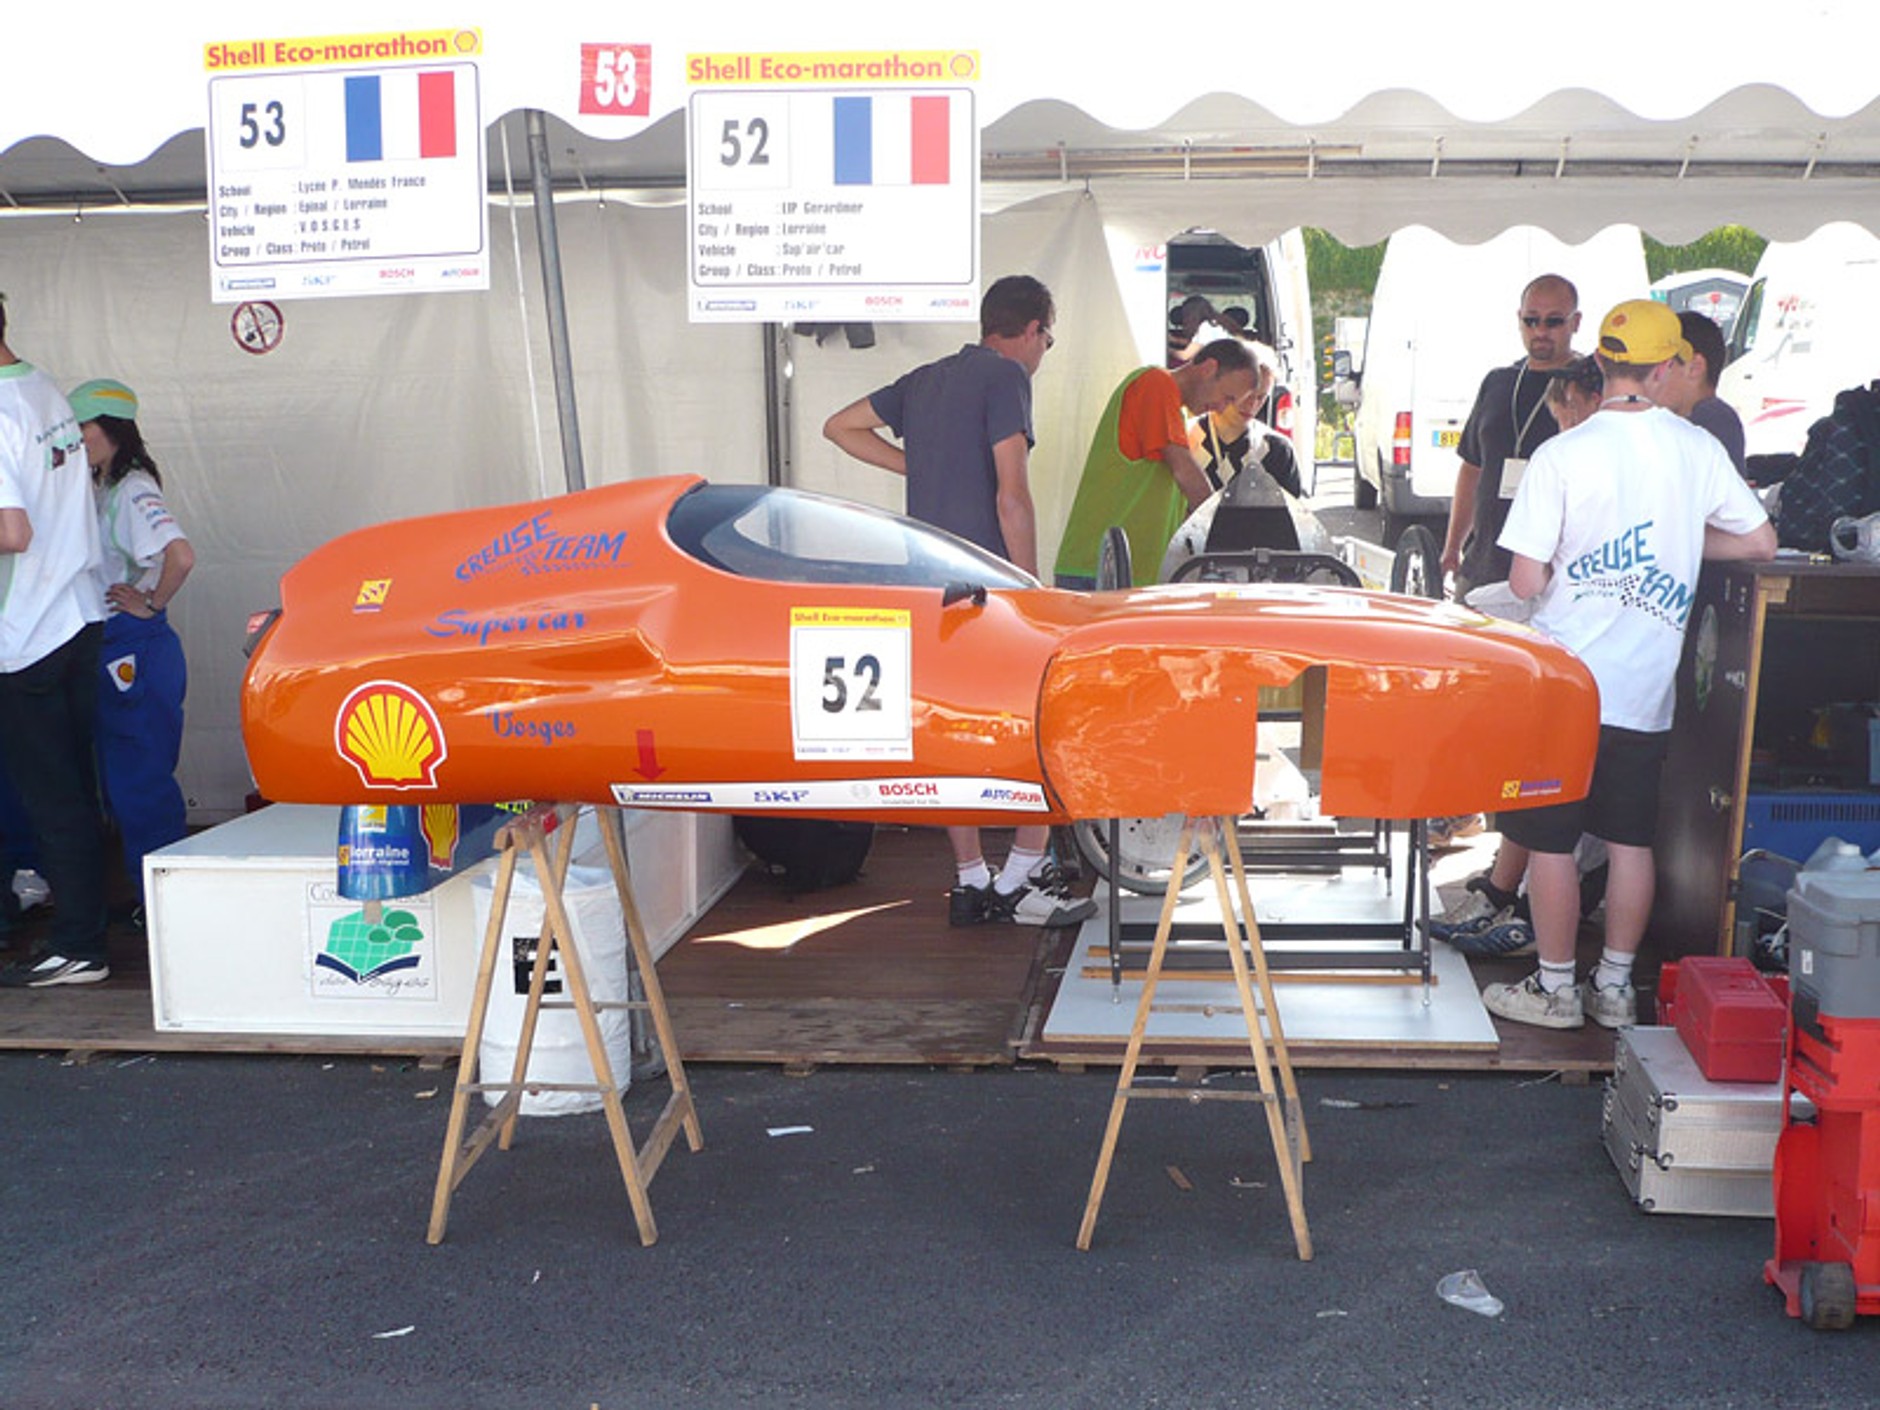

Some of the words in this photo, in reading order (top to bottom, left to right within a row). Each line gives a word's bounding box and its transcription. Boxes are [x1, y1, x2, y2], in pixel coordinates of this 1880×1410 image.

[207, 42, 265, 68] Shell
[275, 33, 447, 63] Eco-marathon
[594, 50, 637, 108] 53
[689, 56, 751, 81] Shell
[760, 53, 943, 79] Eco-marathon
[240, 100, 286, 149] 53
[719, 117, 770, 166] 52
[218, 184, 253, 199] School
[391, 174, 426, 189] France
[219, 203, 239, 220] City
[254, 201, 288, 218] Region
[343, 197, 388, 212] Lorraine
[698, 202, 733, 216] School
[220, 224, 255, 239] Vehicle
[698, 223, 718, 238] City
[735, 222, 770, 238] Region
[782, 222, 827, 236] Lorraine
[221, 244, 251, 258] Group
[265, 241, 293, 256] Class
[300, 240, 326, 253] Proto
[341, 238, 370, 252] Petrol
[698, 243, 737, 258] Vehicle
[698, 263, 731, 279] Group
[747, 263, 775, 277] Class
[782, 263, 812, 277] Proto
[829, 262, 862, 277] Petrol
[455, 508, 558, 584] CREUSE
[544, 530, 628, 562] TEAM
[1567, 520, 1655, 580] CREUSE
[794, 611, 819, 623] Shell
[822, 611, 896, 624] Eco-marathon
[822, 653, 883, 714] 52
[485, 708, 577, 747] Vosges
[754, 789, 810, 802] SKF
[879, 782, 939, 796] BOSCH
[350, 844, 410, 859] lorraine
